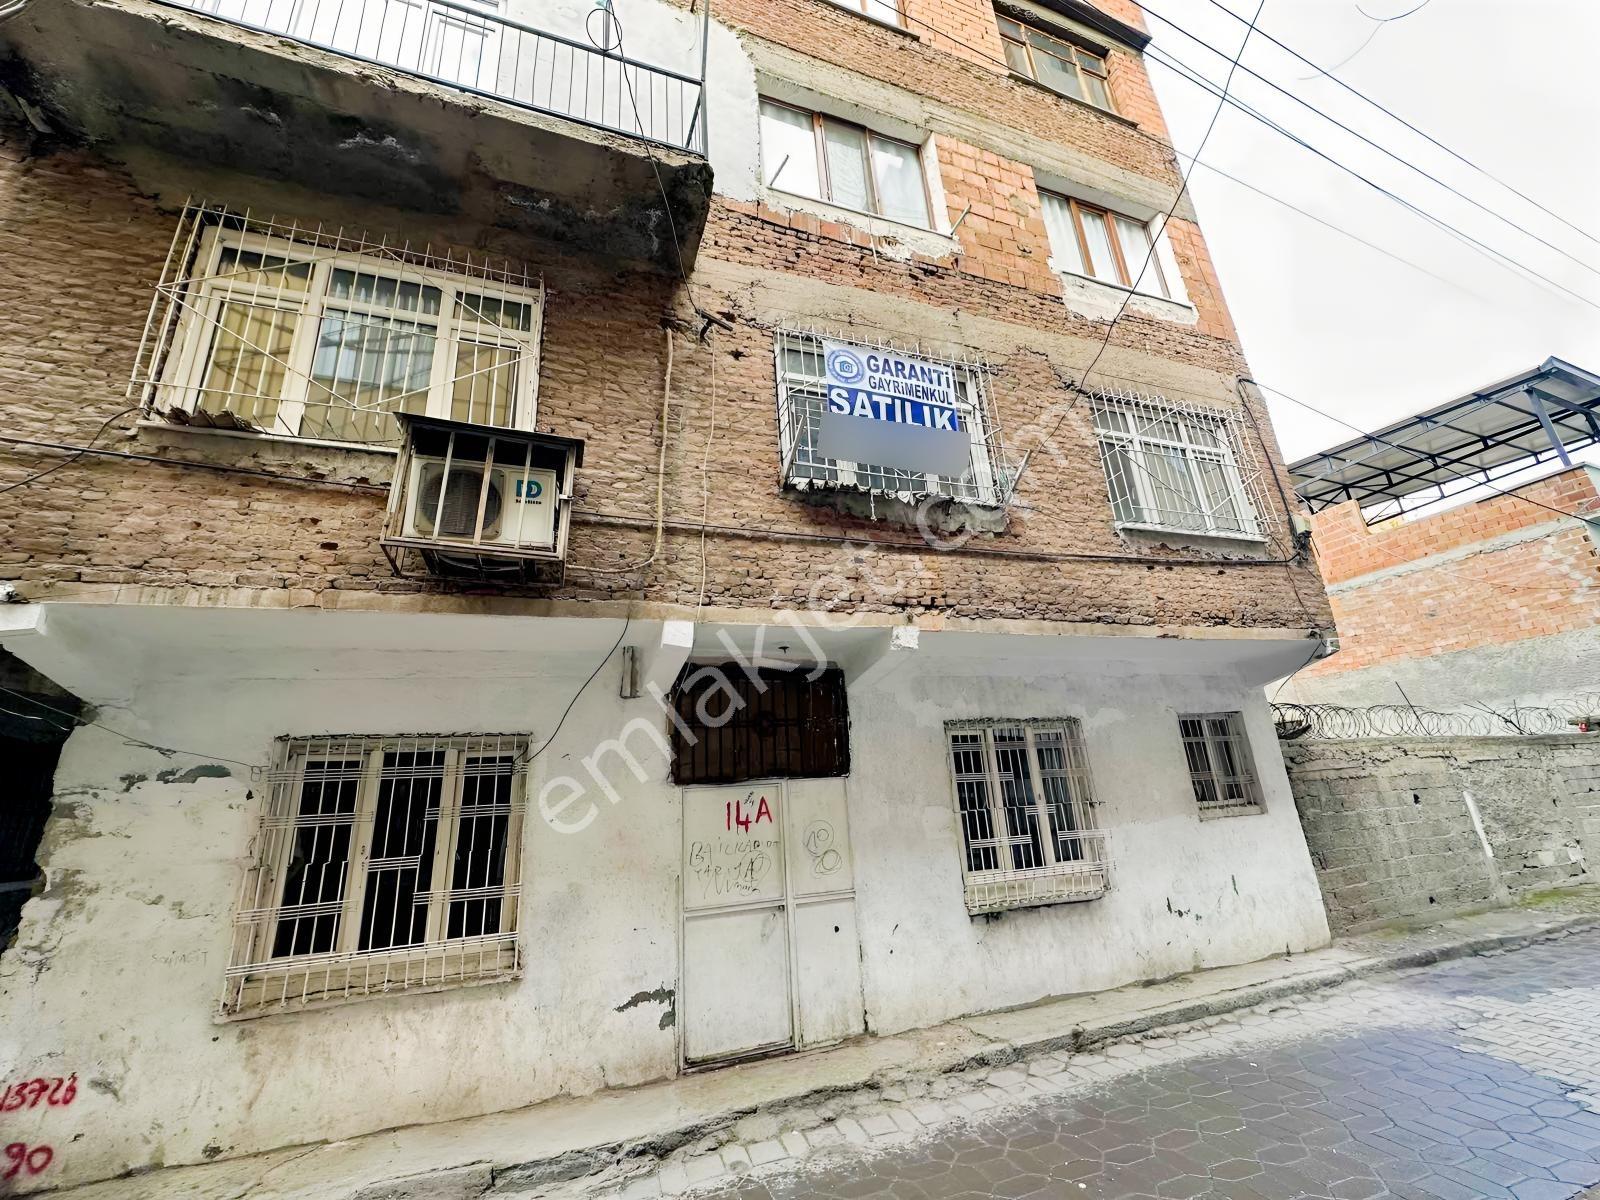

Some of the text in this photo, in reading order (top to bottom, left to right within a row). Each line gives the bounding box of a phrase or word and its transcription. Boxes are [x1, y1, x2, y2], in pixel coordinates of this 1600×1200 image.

[829, 388, 953, 431] SATILIK
[726, 796, 773, 833] 14A
[2, 1142, 53, 1180] 90
